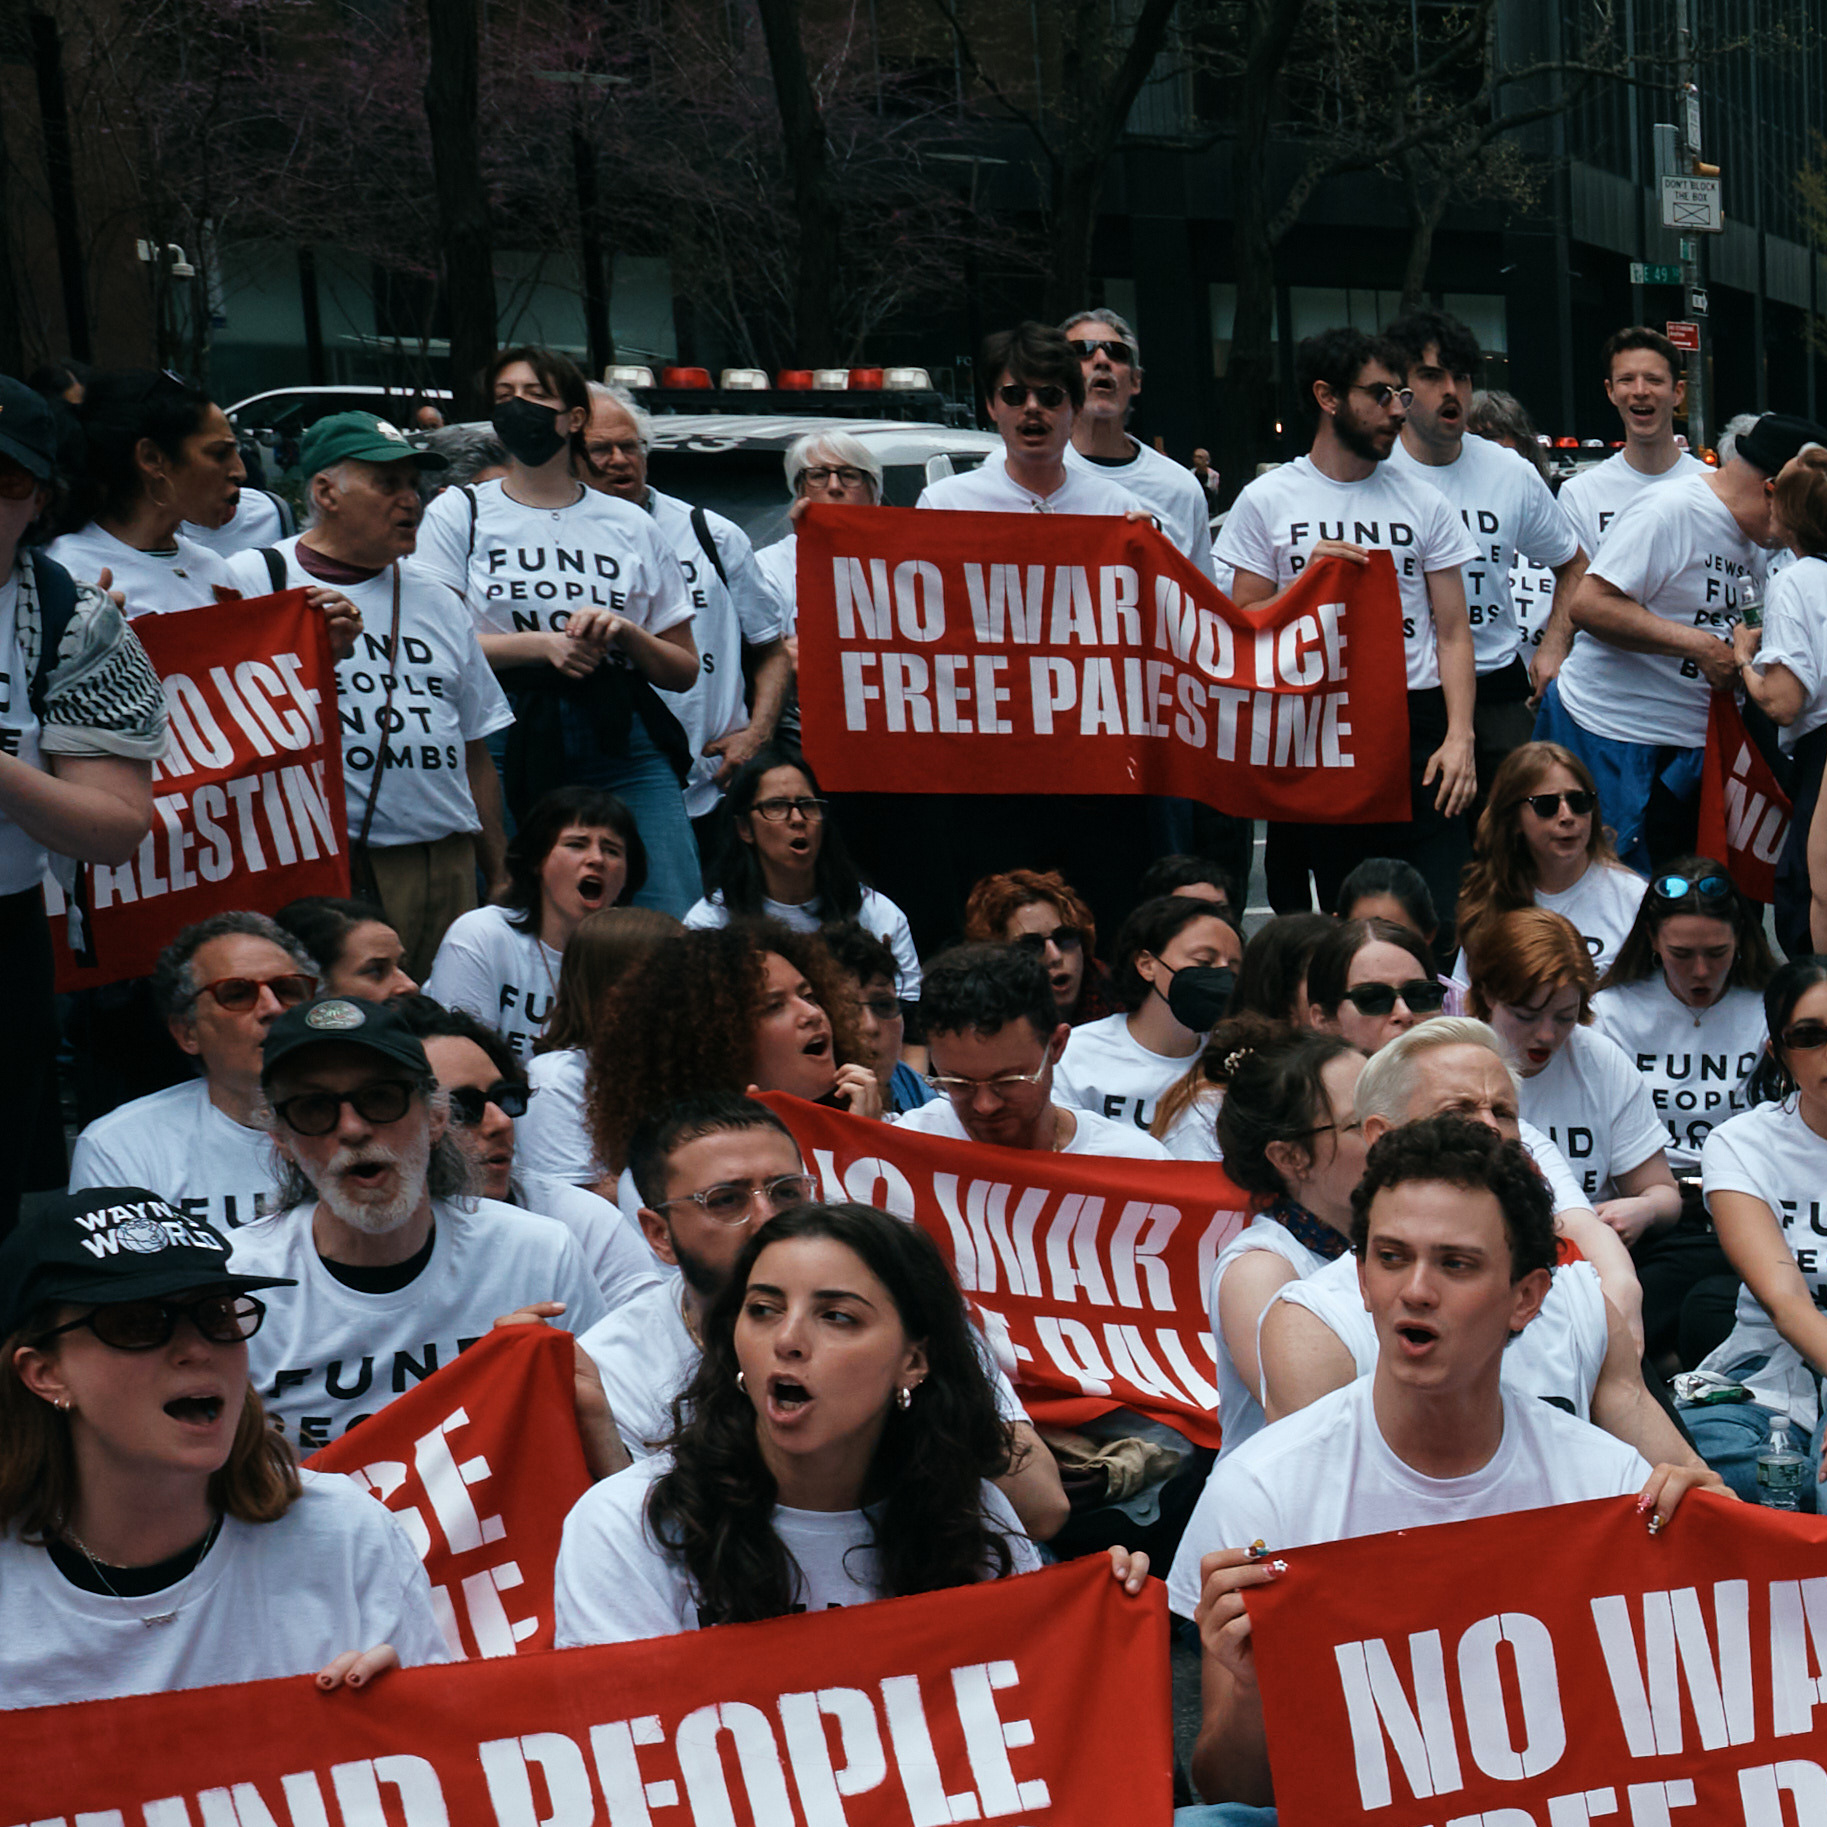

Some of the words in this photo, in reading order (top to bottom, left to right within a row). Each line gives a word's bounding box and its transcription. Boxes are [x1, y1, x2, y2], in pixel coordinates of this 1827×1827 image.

[1675, 190, 1689, 201] THE
[1692, 192, 1708, 202] BOX
[1690, 181, 1716, 192] BLOCK
[1290, 521, 1416, 548] FUND
[489, 547, 621, 580] FUND
[487, 579, 627, 612] PEOPLE
[1705, 577, 1739, 611] FU
[511, 610, 570, 633] NO
[832, 556, 946, 643] NO
[962, 562, 1143, 646] WAR
[1155, 574, 1236, 680] NO
[1254, 601, 1349, 688] ICE
[336, 671, 443, 698] EOPLE
[209, 652, 325, 758] ICE
[840, 651, 1013, 735] FREE
[1029, 655, 1356, 769] PALESTINE
[344, 744, 458, 770] OMBS
[500, 983, 555, 1024] FU
[1103, 1094, 1153, 1132] FU
[181, 1194, 264, 1229] FU
[932, 1171, 1178, 1312] WAR
[1332, 1609, 1568, 1812] NO
